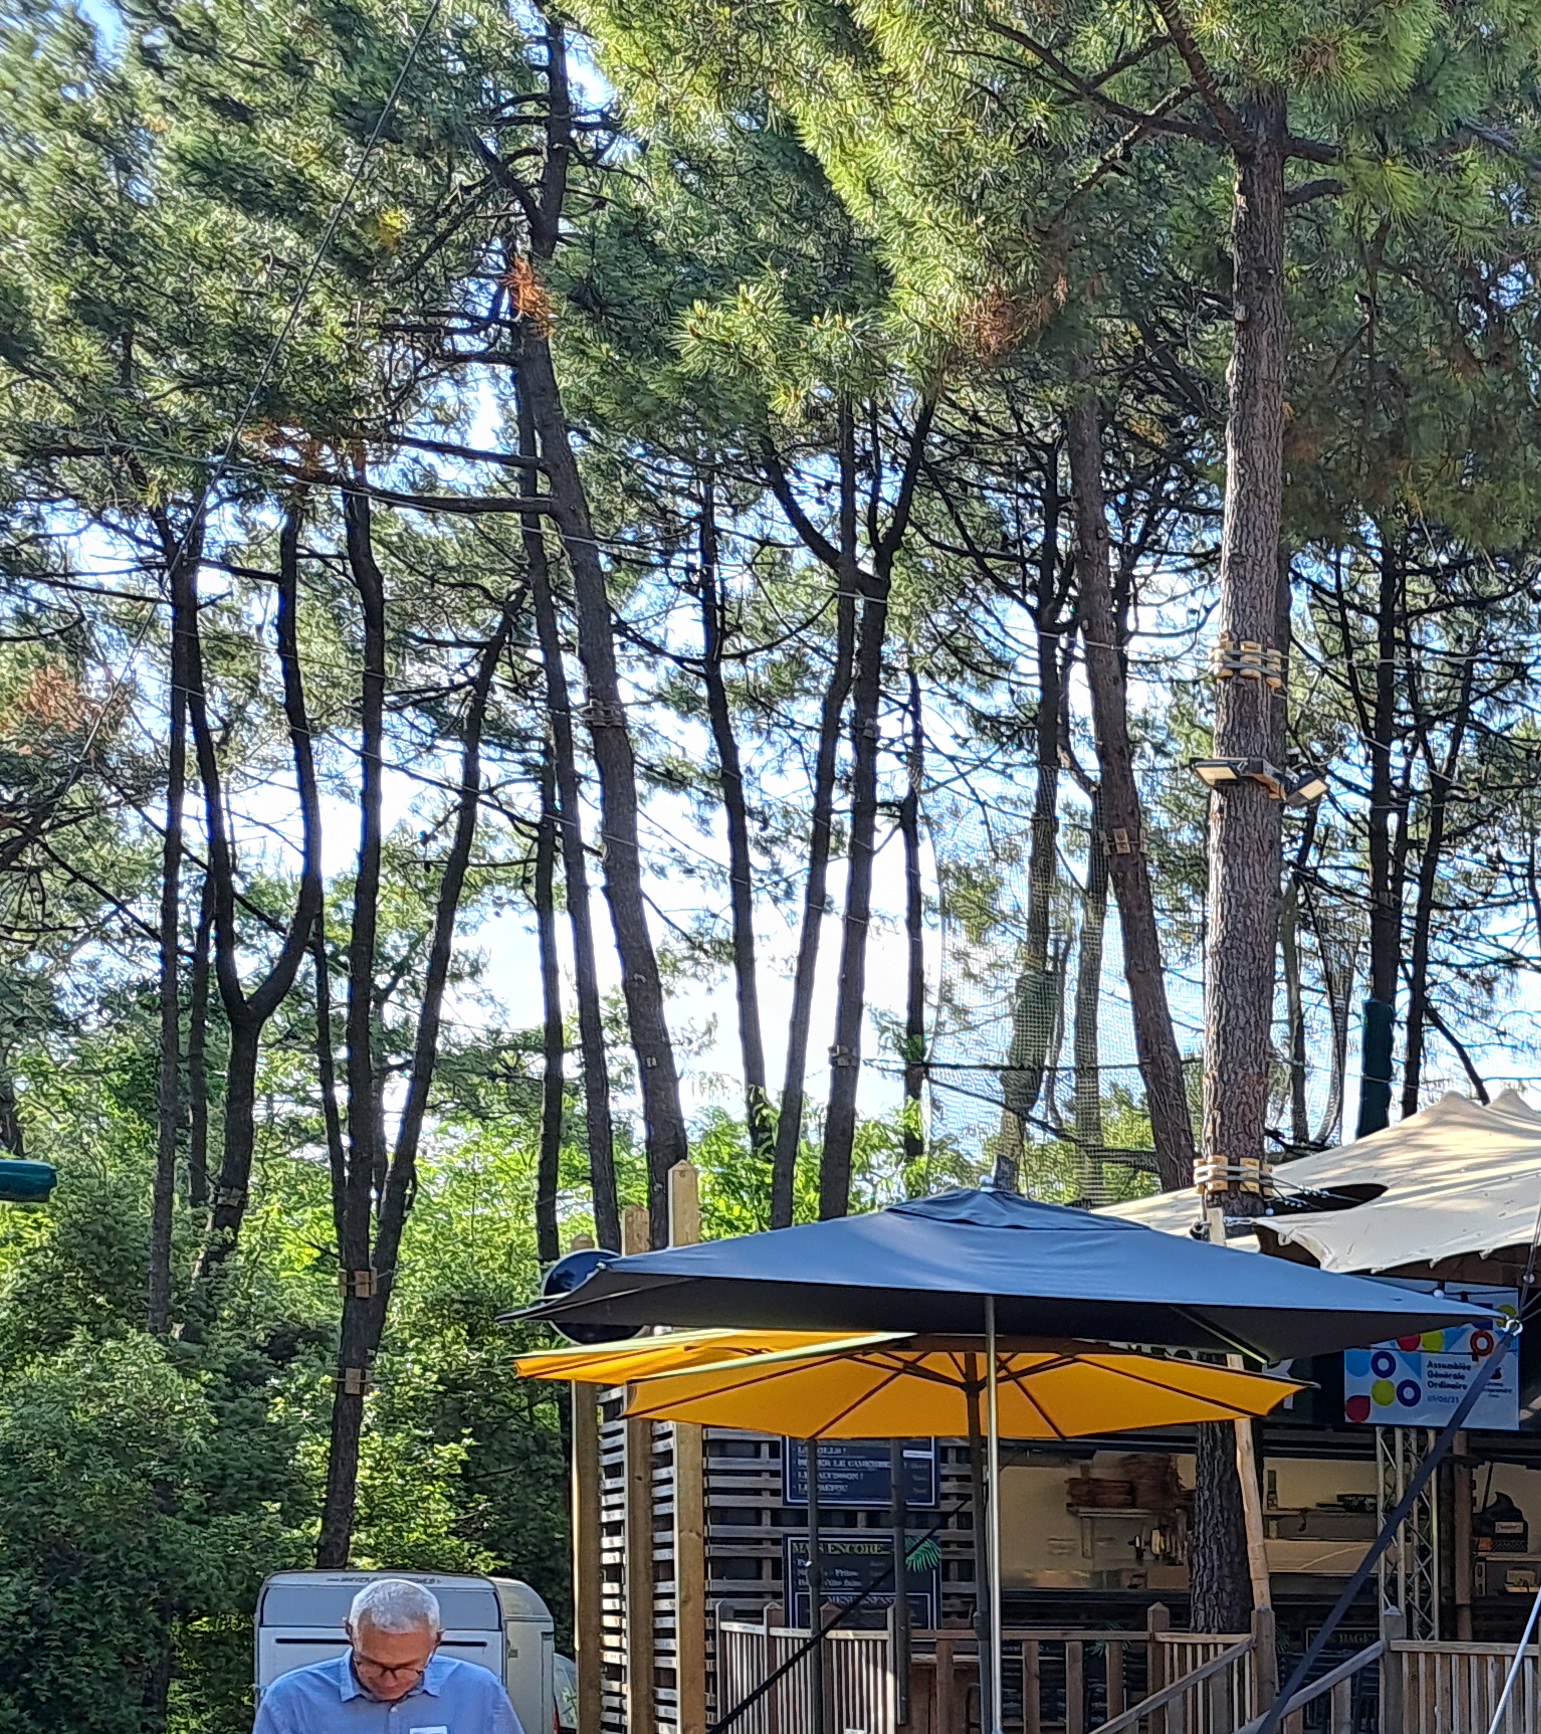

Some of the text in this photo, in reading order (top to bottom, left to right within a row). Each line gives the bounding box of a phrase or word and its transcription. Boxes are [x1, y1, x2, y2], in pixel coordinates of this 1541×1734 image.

[1427, 1360, 1472, 1371] Assemblée
[1427, 1370, 1466, 1380] Générale
[1427, 1380, 1468, 1390] Ordinaire
